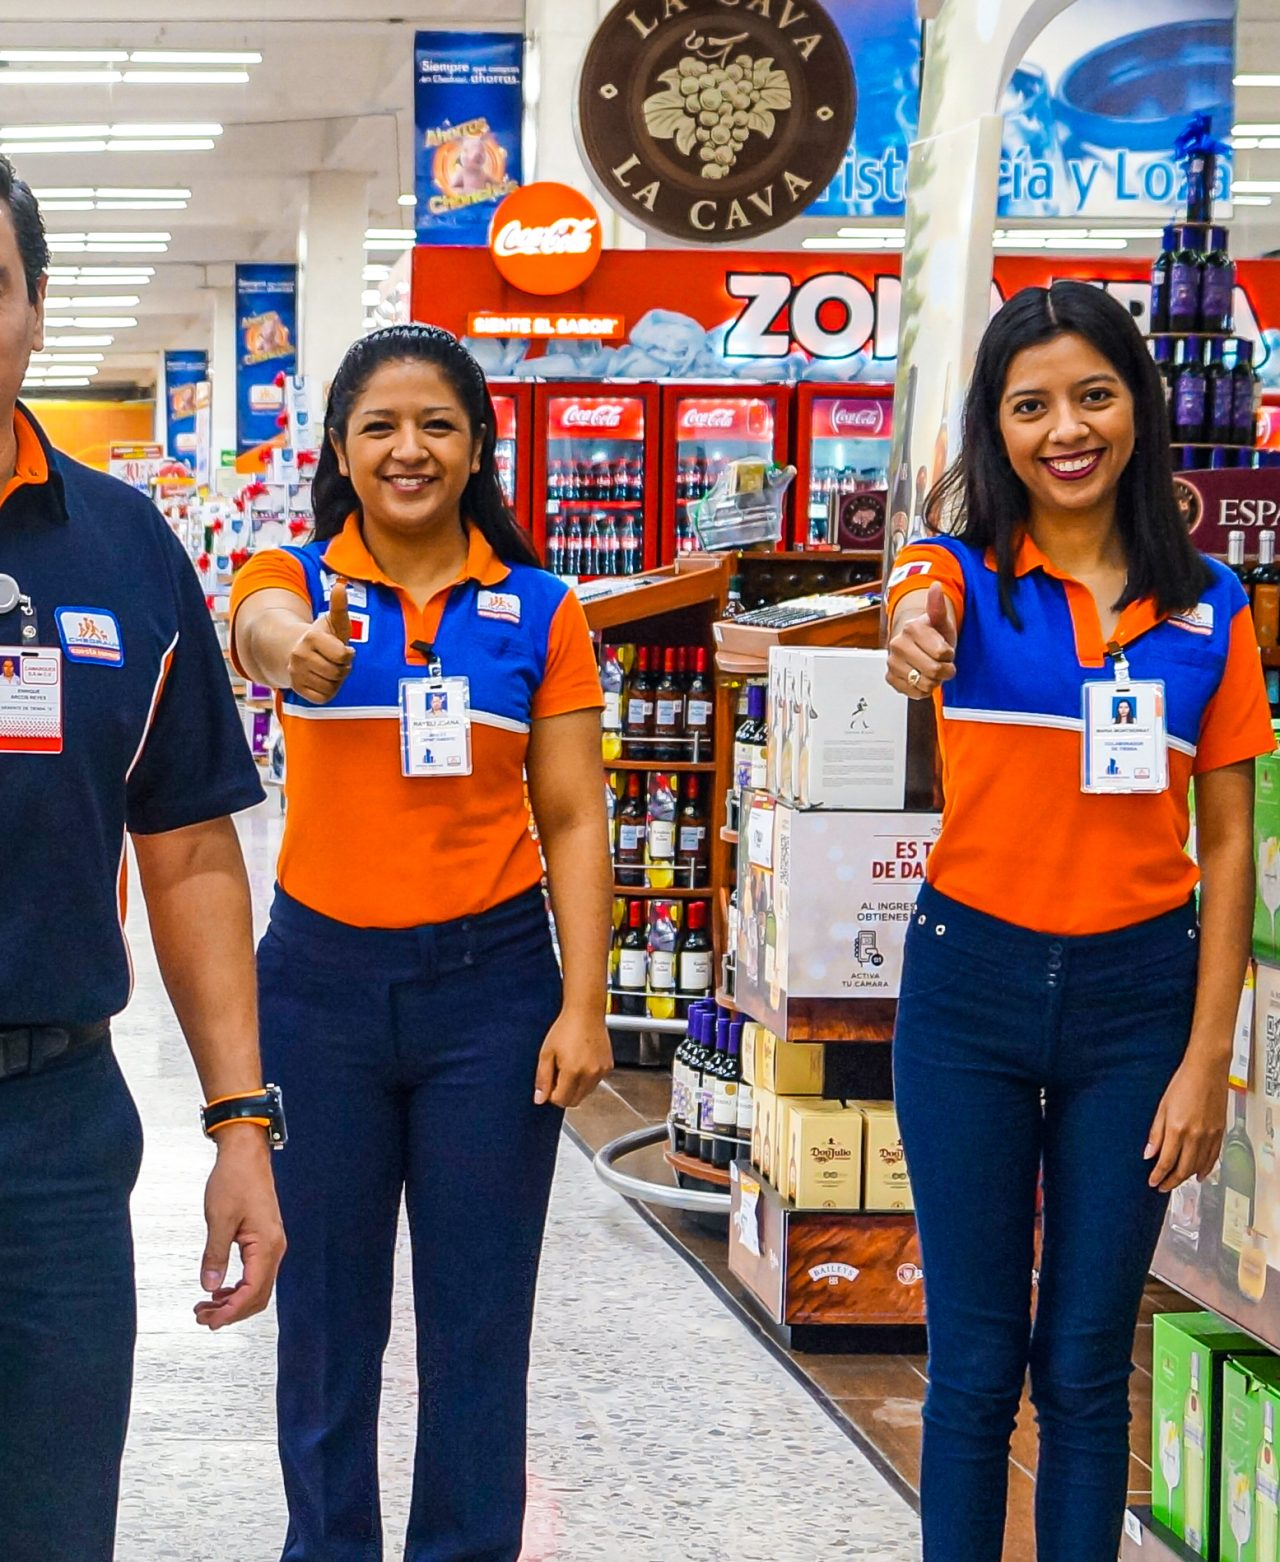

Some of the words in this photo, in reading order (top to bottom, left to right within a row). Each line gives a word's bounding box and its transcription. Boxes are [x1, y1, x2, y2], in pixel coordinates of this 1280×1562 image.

[724, 0, 822, 61] AVA
[422, 60, 470, 75] Siempre
[612, 154, 661, 212] LA
[690, 170, 812, 230] CAVA
[1068, 160, 1103, 212] y
[723, 270, 901, 361] ZO
[473, 317, 531, 334] SIENTE
[532, 318, 555, 334] EL
[555, 318, 614, 335] SABOR
[1218, 499, 1280, 527] ESP
[896, 841, 918, 859] ES
[872, 861, 896, 879] DE
[901, 861, 925, 879] DA
[861, 902, 875, 911] AL
[878, 902, 917, 911] INGRES
[857, 912, 909, 921] OBTIENES
[813, 1265, 854, 1277] BAILEYS
